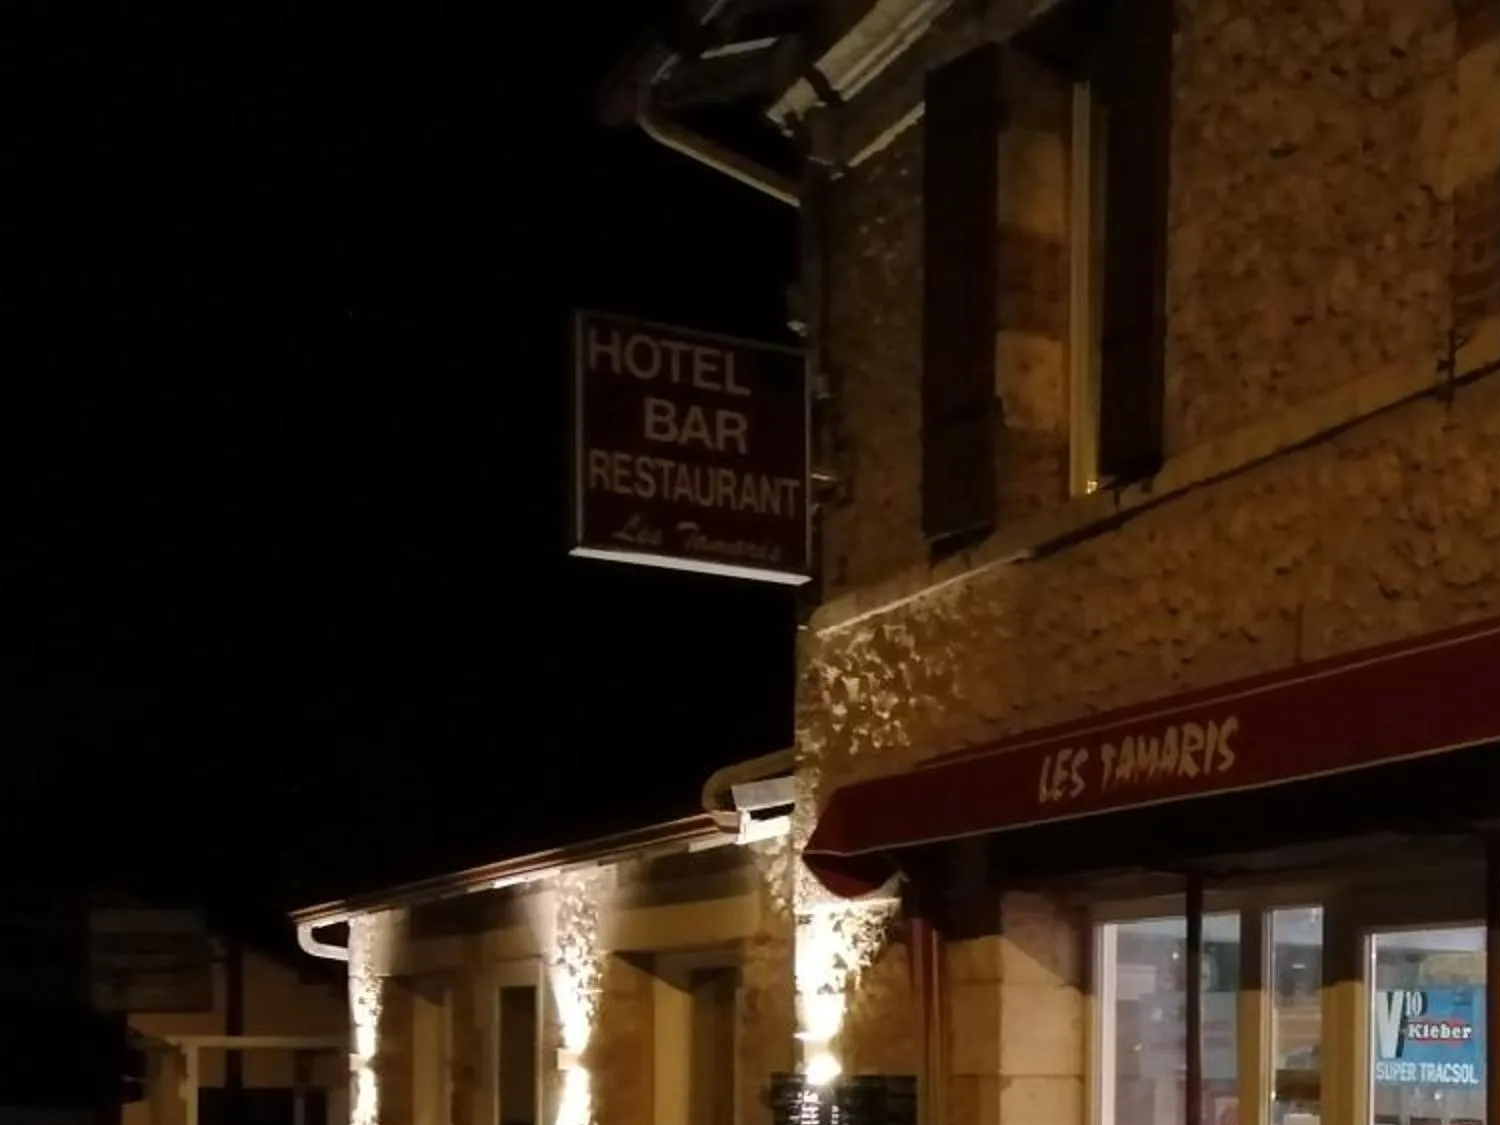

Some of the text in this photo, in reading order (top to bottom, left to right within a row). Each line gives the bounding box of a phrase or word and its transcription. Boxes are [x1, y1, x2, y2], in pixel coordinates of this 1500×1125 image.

[588, 326, 753, 397] HOTEL
[643, 396, 750, 456] BAR
[588, 447, 800, 519] RESTAURANT
[1039, 715, 1240, 804] LES TAMARIS
[1375, 1062, 1417, 1081] SUPER
